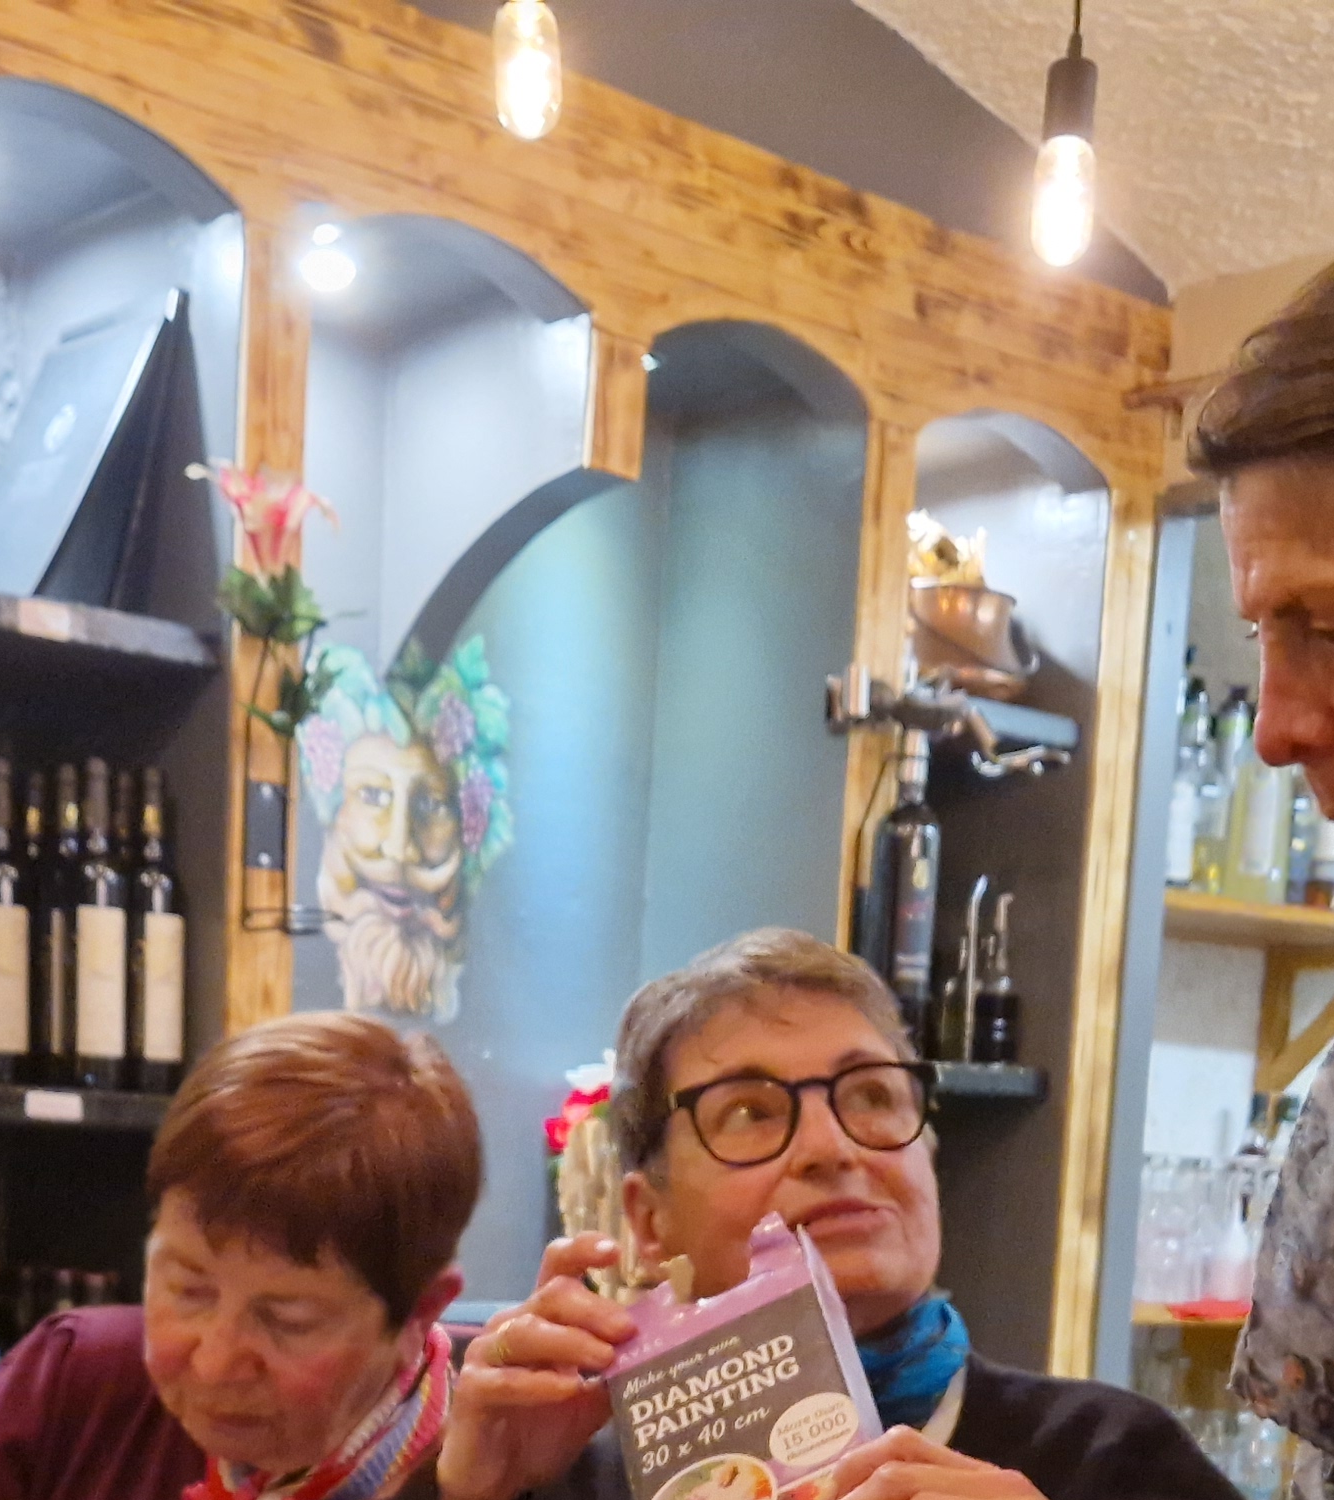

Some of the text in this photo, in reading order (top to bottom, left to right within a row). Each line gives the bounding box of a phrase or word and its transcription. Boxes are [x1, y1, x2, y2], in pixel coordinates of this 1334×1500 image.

[623, 1368, 666, 1400] Make
[669, 1350, 705, 1379] your
[628, 1333, 795, 1426] DIAMOND
[634, 1355, 801, 1449] PAINTING
[640, 1404, 771, 1475] 30 x 40 cm
[783, 1411, 847, 1451] 15 000
